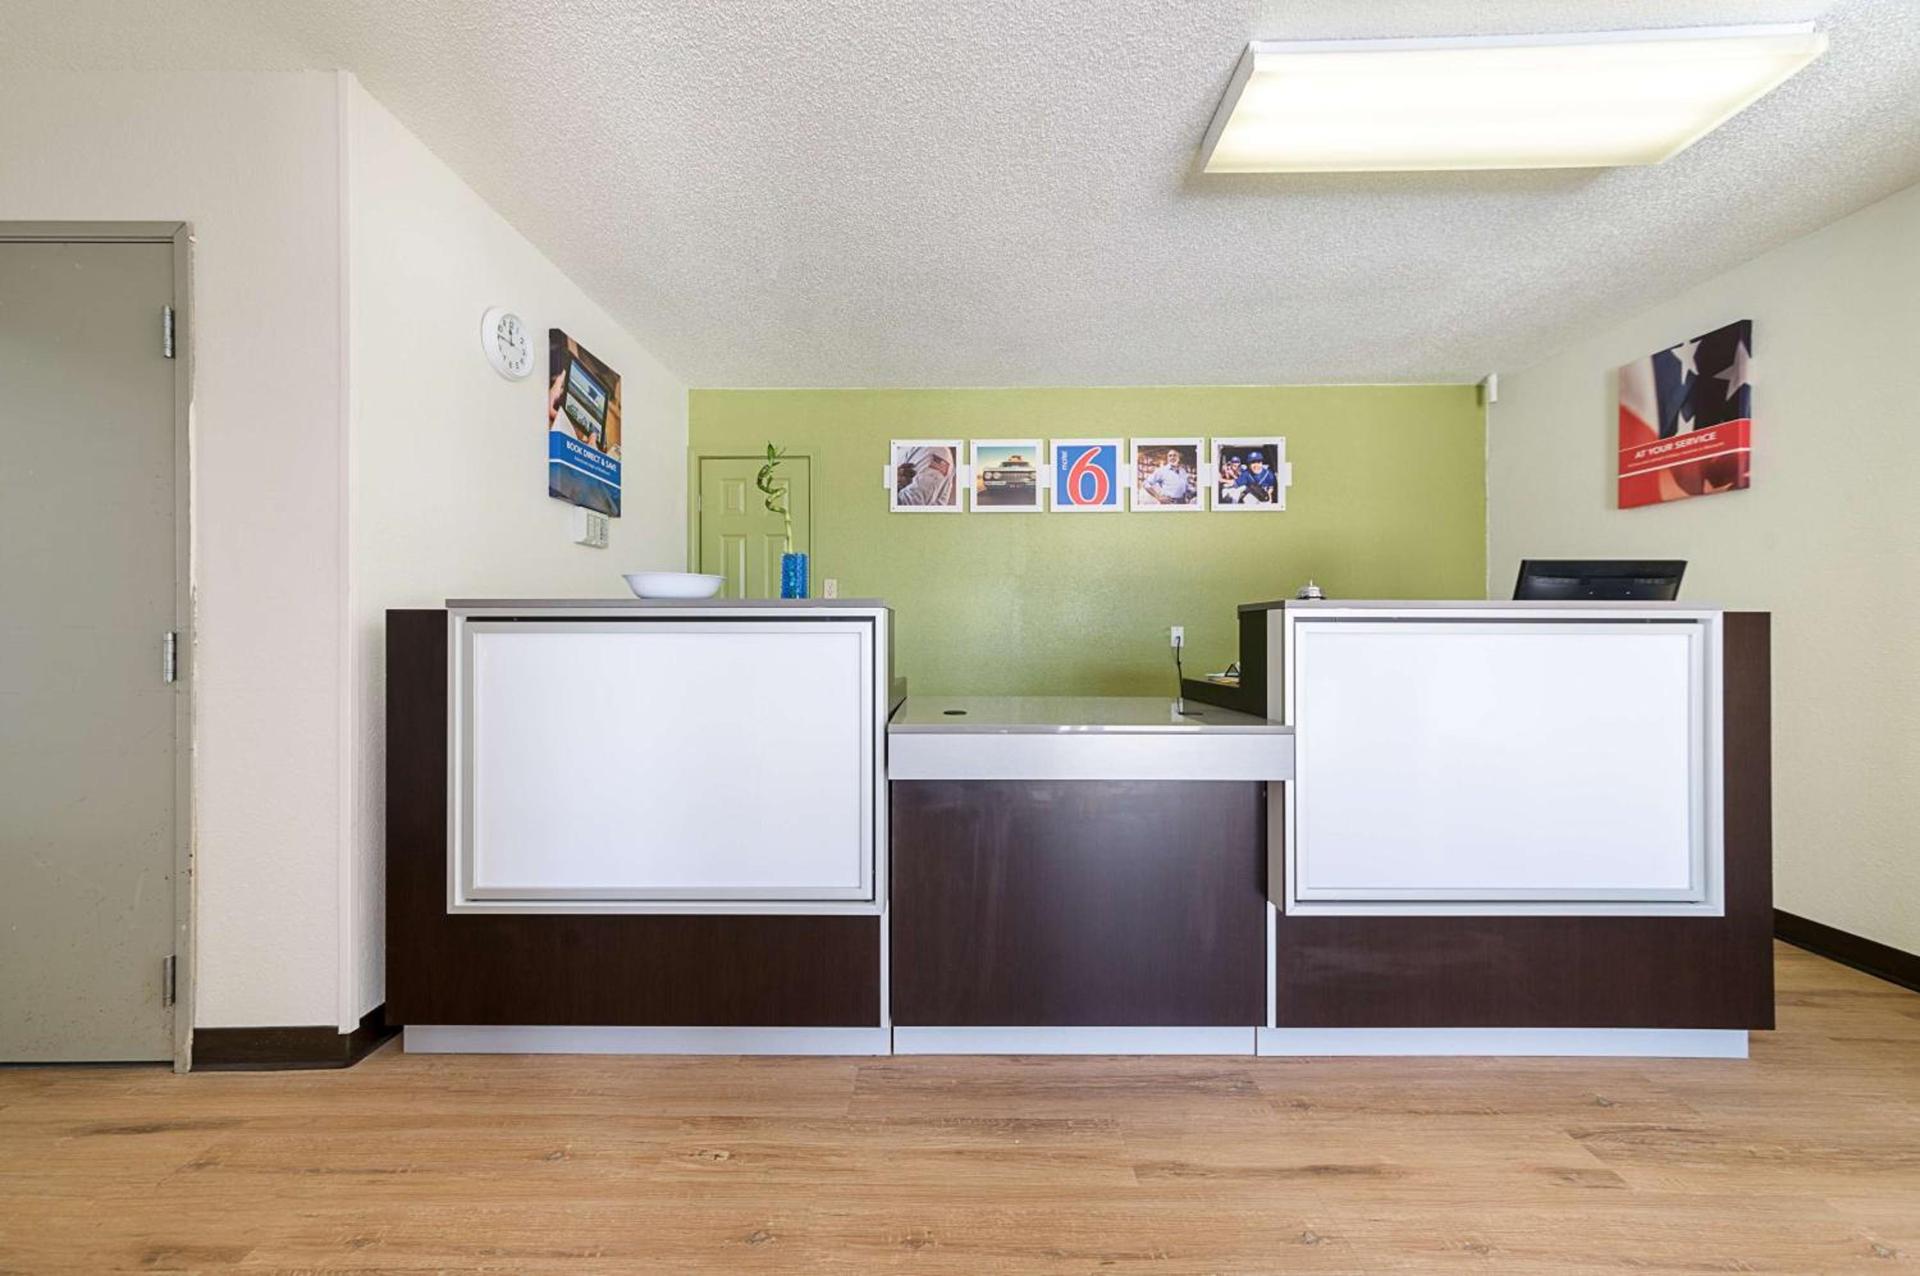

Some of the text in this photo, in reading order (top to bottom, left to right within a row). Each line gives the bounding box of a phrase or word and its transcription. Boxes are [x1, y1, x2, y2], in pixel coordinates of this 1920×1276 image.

[566, 441, 583, 454] BOOK
[583, 448, 601, 464] DIRECT
[1634, 450, 1646, 459] AT
[1648, 443, 1673, 455] YOUR
[1675, 431, 1717, 449] SERVICE
[1067, 447, 1110, 505] 6
